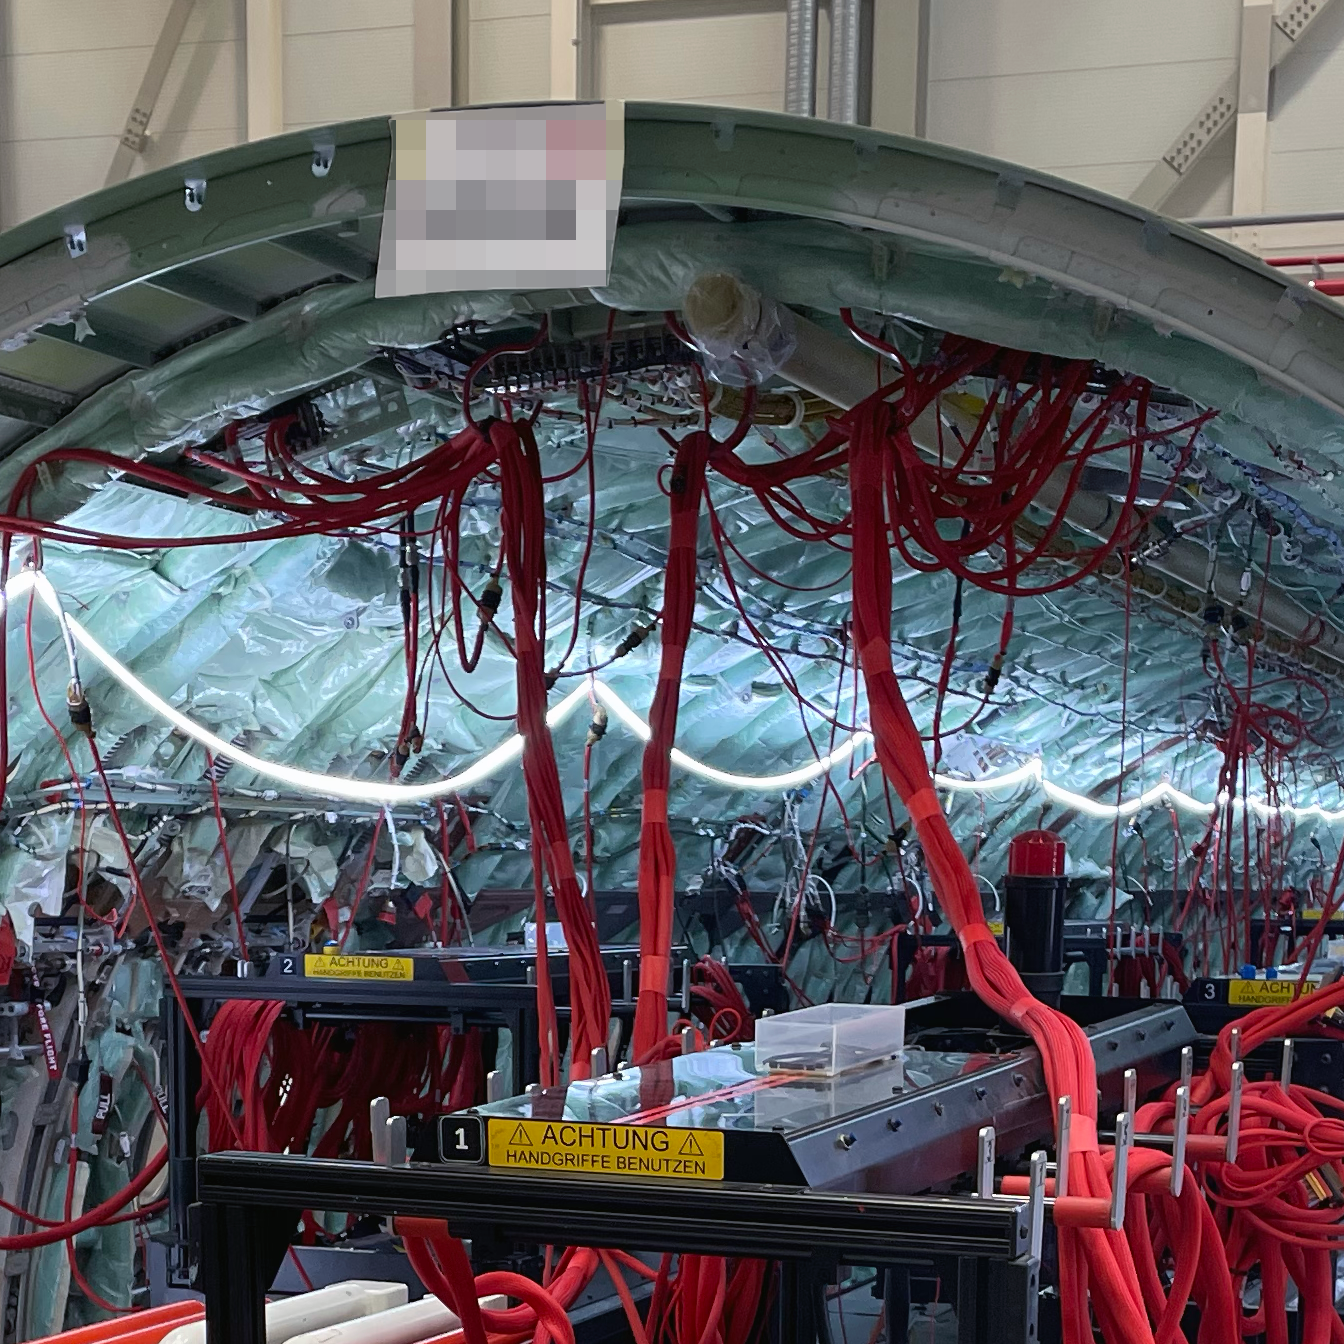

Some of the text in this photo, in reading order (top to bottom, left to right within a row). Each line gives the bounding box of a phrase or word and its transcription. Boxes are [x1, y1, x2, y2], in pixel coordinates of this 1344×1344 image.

[283, 958, 293, 974] 2
[329, 957, 389, 970] ACHTUNG
[312, 969, 406, 979] HANDGRIFFE BENUTZEN
[1204, 983, 1216, 1000] 3
[1259, 981, 1320, 995] ACHTUN
[43, 1033, 58, 1071] FLIGHT
[95, 1093, 111, 1120] PULL
[454, 1127, 469, 1150] 1
[541, 1124, 670, 1152] ACHTUNG
[506, 1149, 706, 1175] HANDGRIFFE BENUTZEN
